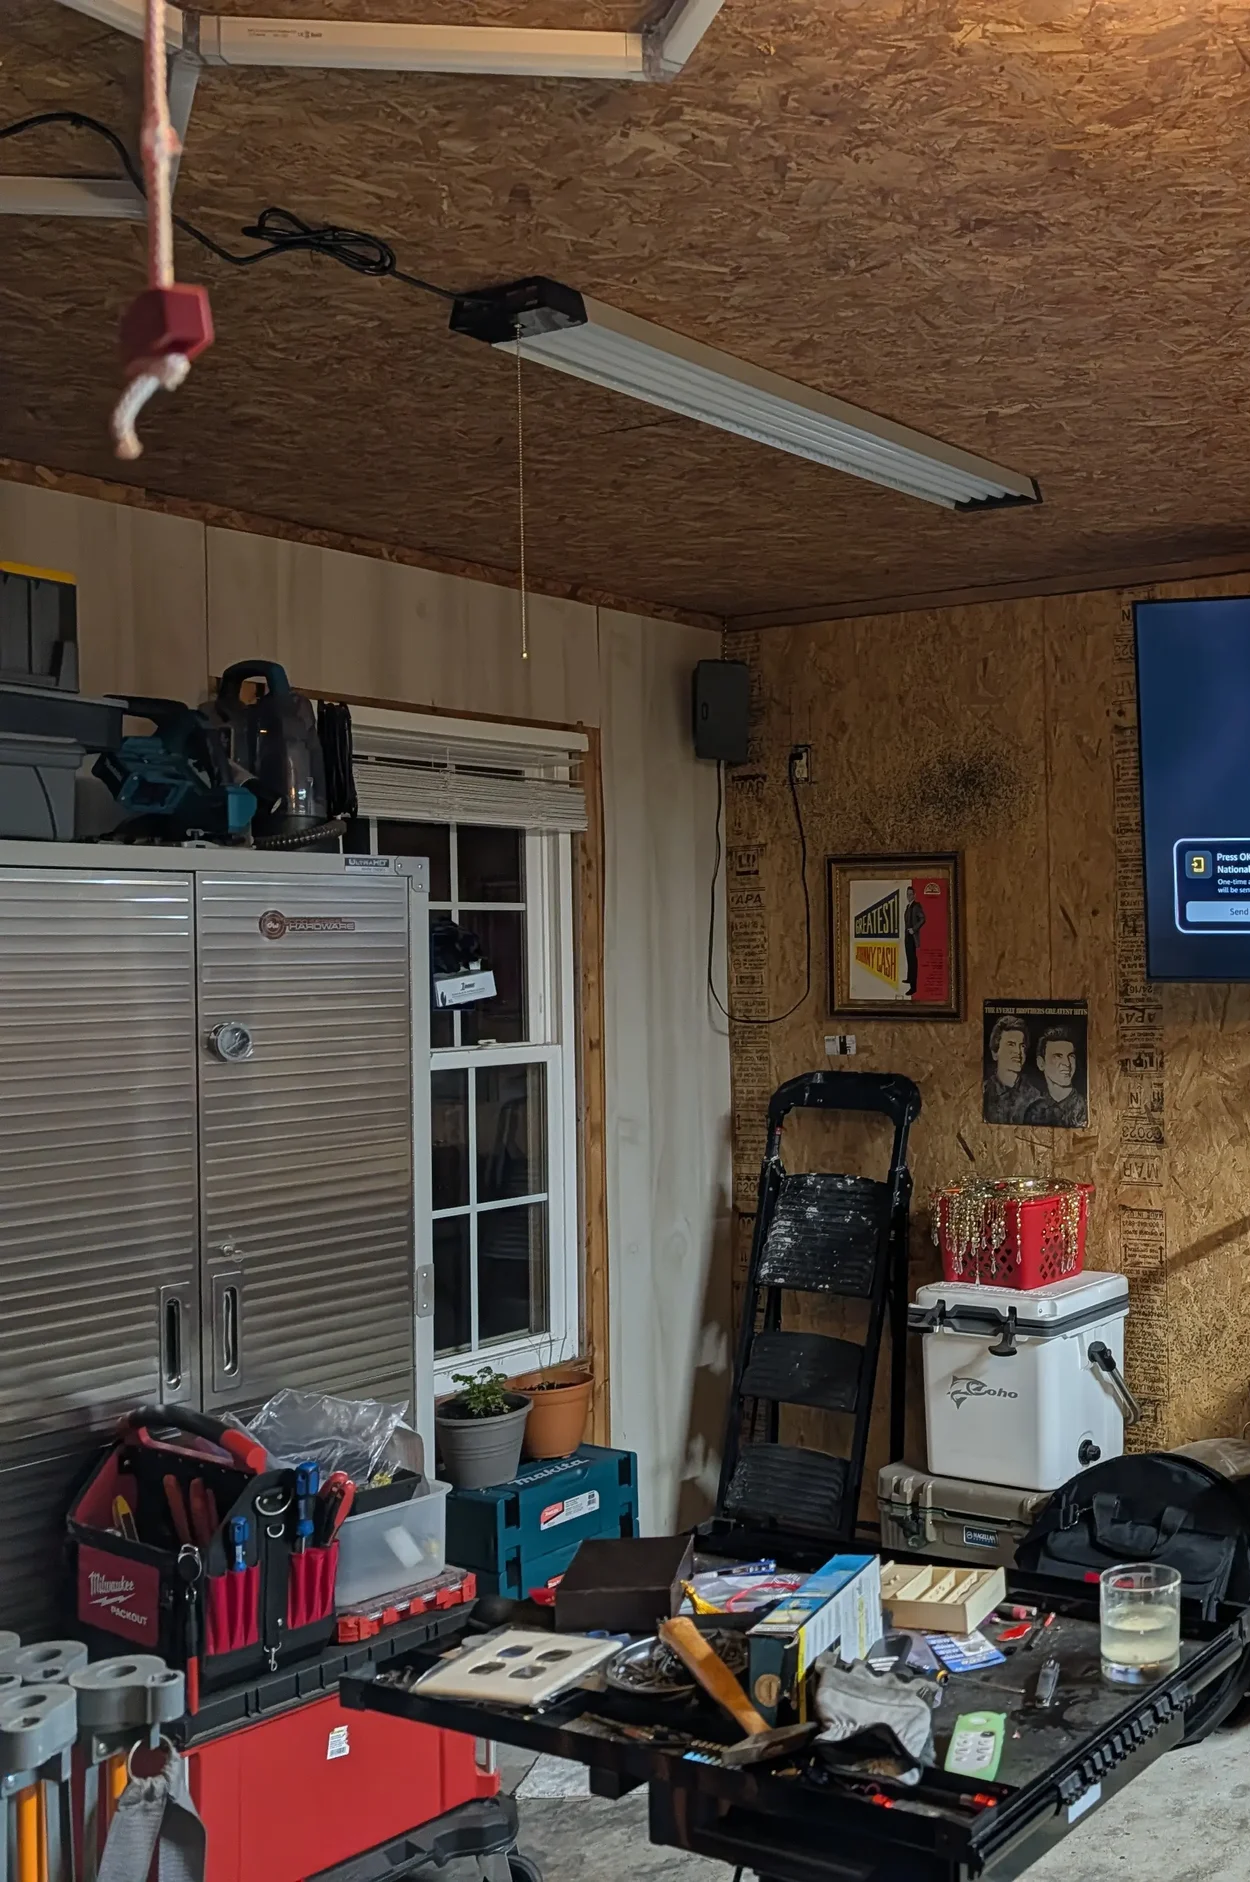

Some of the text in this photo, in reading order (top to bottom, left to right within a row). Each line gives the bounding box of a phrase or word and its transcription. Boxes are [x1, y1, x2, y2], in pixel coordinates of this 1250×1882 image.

[1216, 852, 1238, 862] Press
[1217, 865, 1250, 874] National
[1218, 878, 1247, 886] One-time
[1217, 886, 1229, 894] will
[735, 893, 762, 905] APA
[855, 894, 899, 935] GREATEST!
[1230, 907, 1249, 916] Send
[289, 922, 355, 930] HARDWARE
[855, 945, 875, 969] JOHNNY
[876, 946, 897, 982] CASH
[984, 1006, 996, 1014] THE
[1073, 1008, 1088, 1016] HITS
[1122, 1161, 1159, 1180] MAR
[966, 1380, 1019, 1399] Coho
[88, 1570, 135, 1597] Milwaukee
[110, 1605, 148, 1626] PACKOUT
